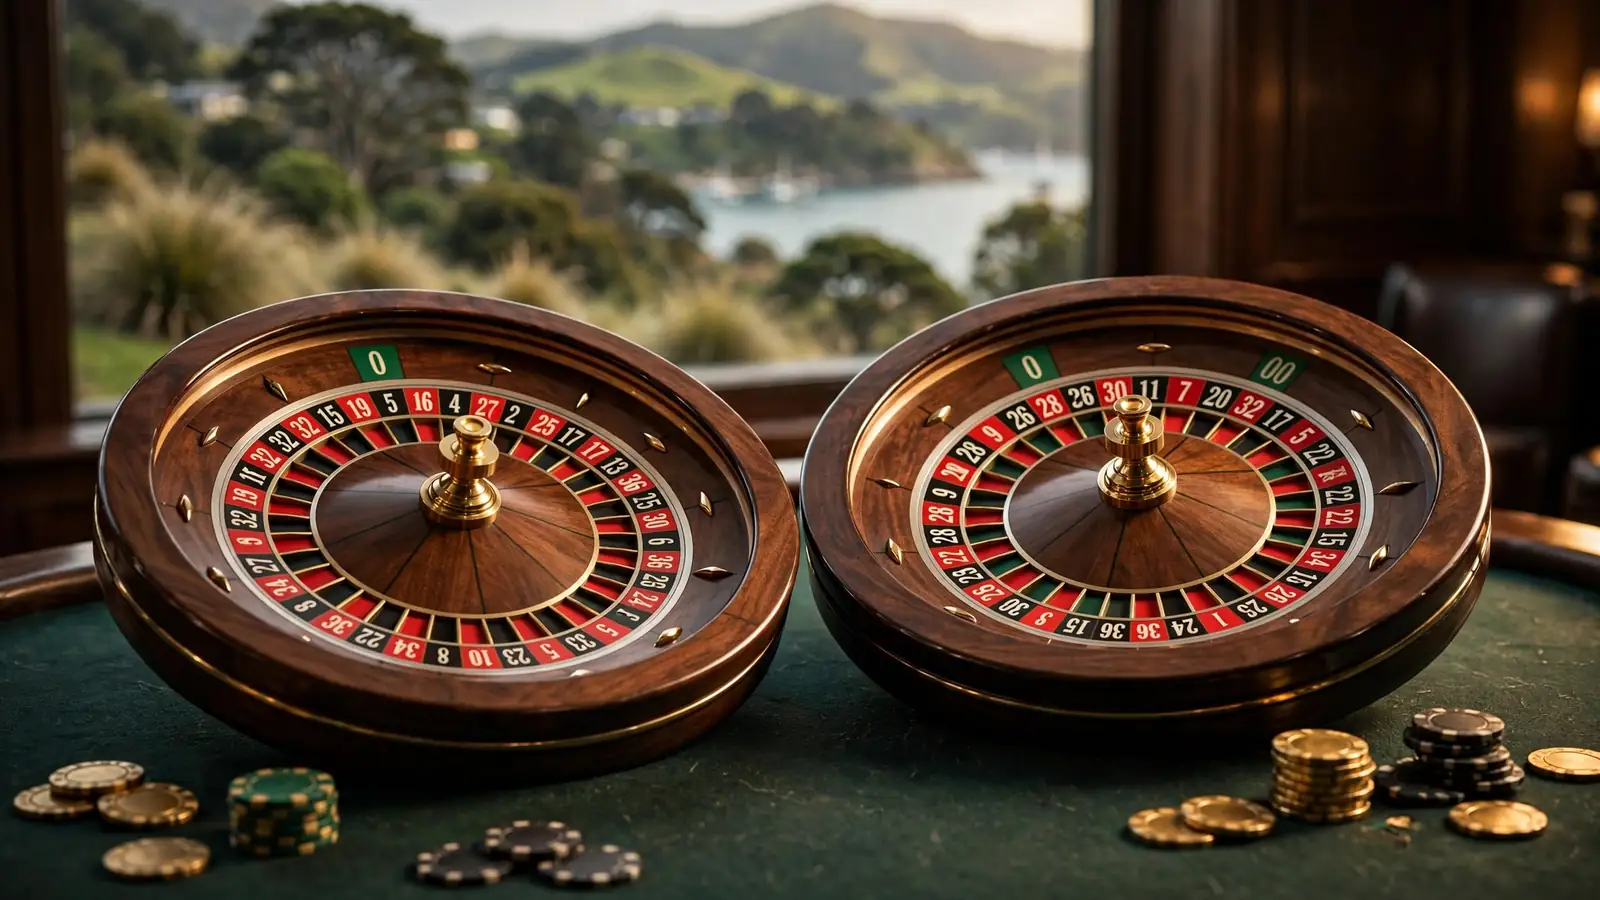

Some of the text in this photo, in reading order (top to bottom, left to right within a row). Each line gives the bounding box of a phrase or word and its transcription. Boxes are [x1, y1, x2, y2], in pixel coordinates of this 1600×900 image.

[368, 350, 387, 376] 0
[1021, 355, 1043, 380] 0
[1260, 356, 1297, 385] 00
[1102, 380, 1128, 401] 30
[1139, 379, 1159, 400] 11
[1177, 380, 1193, 402] 7
[1202, 386, 1232, 409] 20
[346, 397, 373, 420] 19
[382, 392, 399, 414] 5
[413, 390, 434, 412] 16
[448, 393, 461, 413] 4
[474, 397, 500, 418] 27
[1035, 394, 1064, 420] 28
[1233, 395, 1265, 420] 32
[316, 404, 345, 429] 15
[504, 404, 521, 425] 2
[1006, 405, 1036, 430] 26
[1261, 409, 1295, 432] 17
[289, 416, 321, 439] 32
[530, 414, 560, 437] 25
[981, 425, 1004, 443] 9
[268, 429, 300, 454] 32
[557, 426, 586, 447] 17
[1289, 427, 1316, 445] 5
[249, 447, 282, 469] 32
[580, 439, 610, 461] 17
[955, 440, 987, 465] 28
[1302, 443, 1336, 466] 22
[600, 456, 627, 476] 13
[617, 473, 648, 493] 36
[632, 492, 662, 511] 25
[932, 487, 958, 500] 9
[1324, 486, 1355, 505] 22
[230, 509, 258, 529] 32
[642, 512, 670, 530] 30
[928, 506, 955, 524] 28
[1325, 509, 1354, 526] 22
[648, 536, 675, 546] 6
[929, 528, 959, 544] 28
[1317, 531, 1349, 546] 15
[244, 557, 280, 574] 27
[646, 553, 674, 570] 36
[937, 550, 969, 565] 22
[1304, 551, 1338, 568] 34
[264, 578, 299, 597] 34
[972, 583, 1005, 602] 26
[998, 598, 1030, 616] 30
[1062, 618, 1091, 635] 15
[1171, 618, 1199, 637] 24
[1211, 612, 1229, 627] 1
[354, 627, 386, 649] 22
[595, 623, 619, 638] 5
[1099, 623, 1126, 640] 36
[1136, 623, 1161, 640] 36
[392, 639, 421, 659] 34
[539, 643, 561, 660] 5
[564, 633, 597, 652] 33
[437, 647, 450, 665] 8
[468, 649, 494, 667] 10
[501, 647, 532, 666] 23
